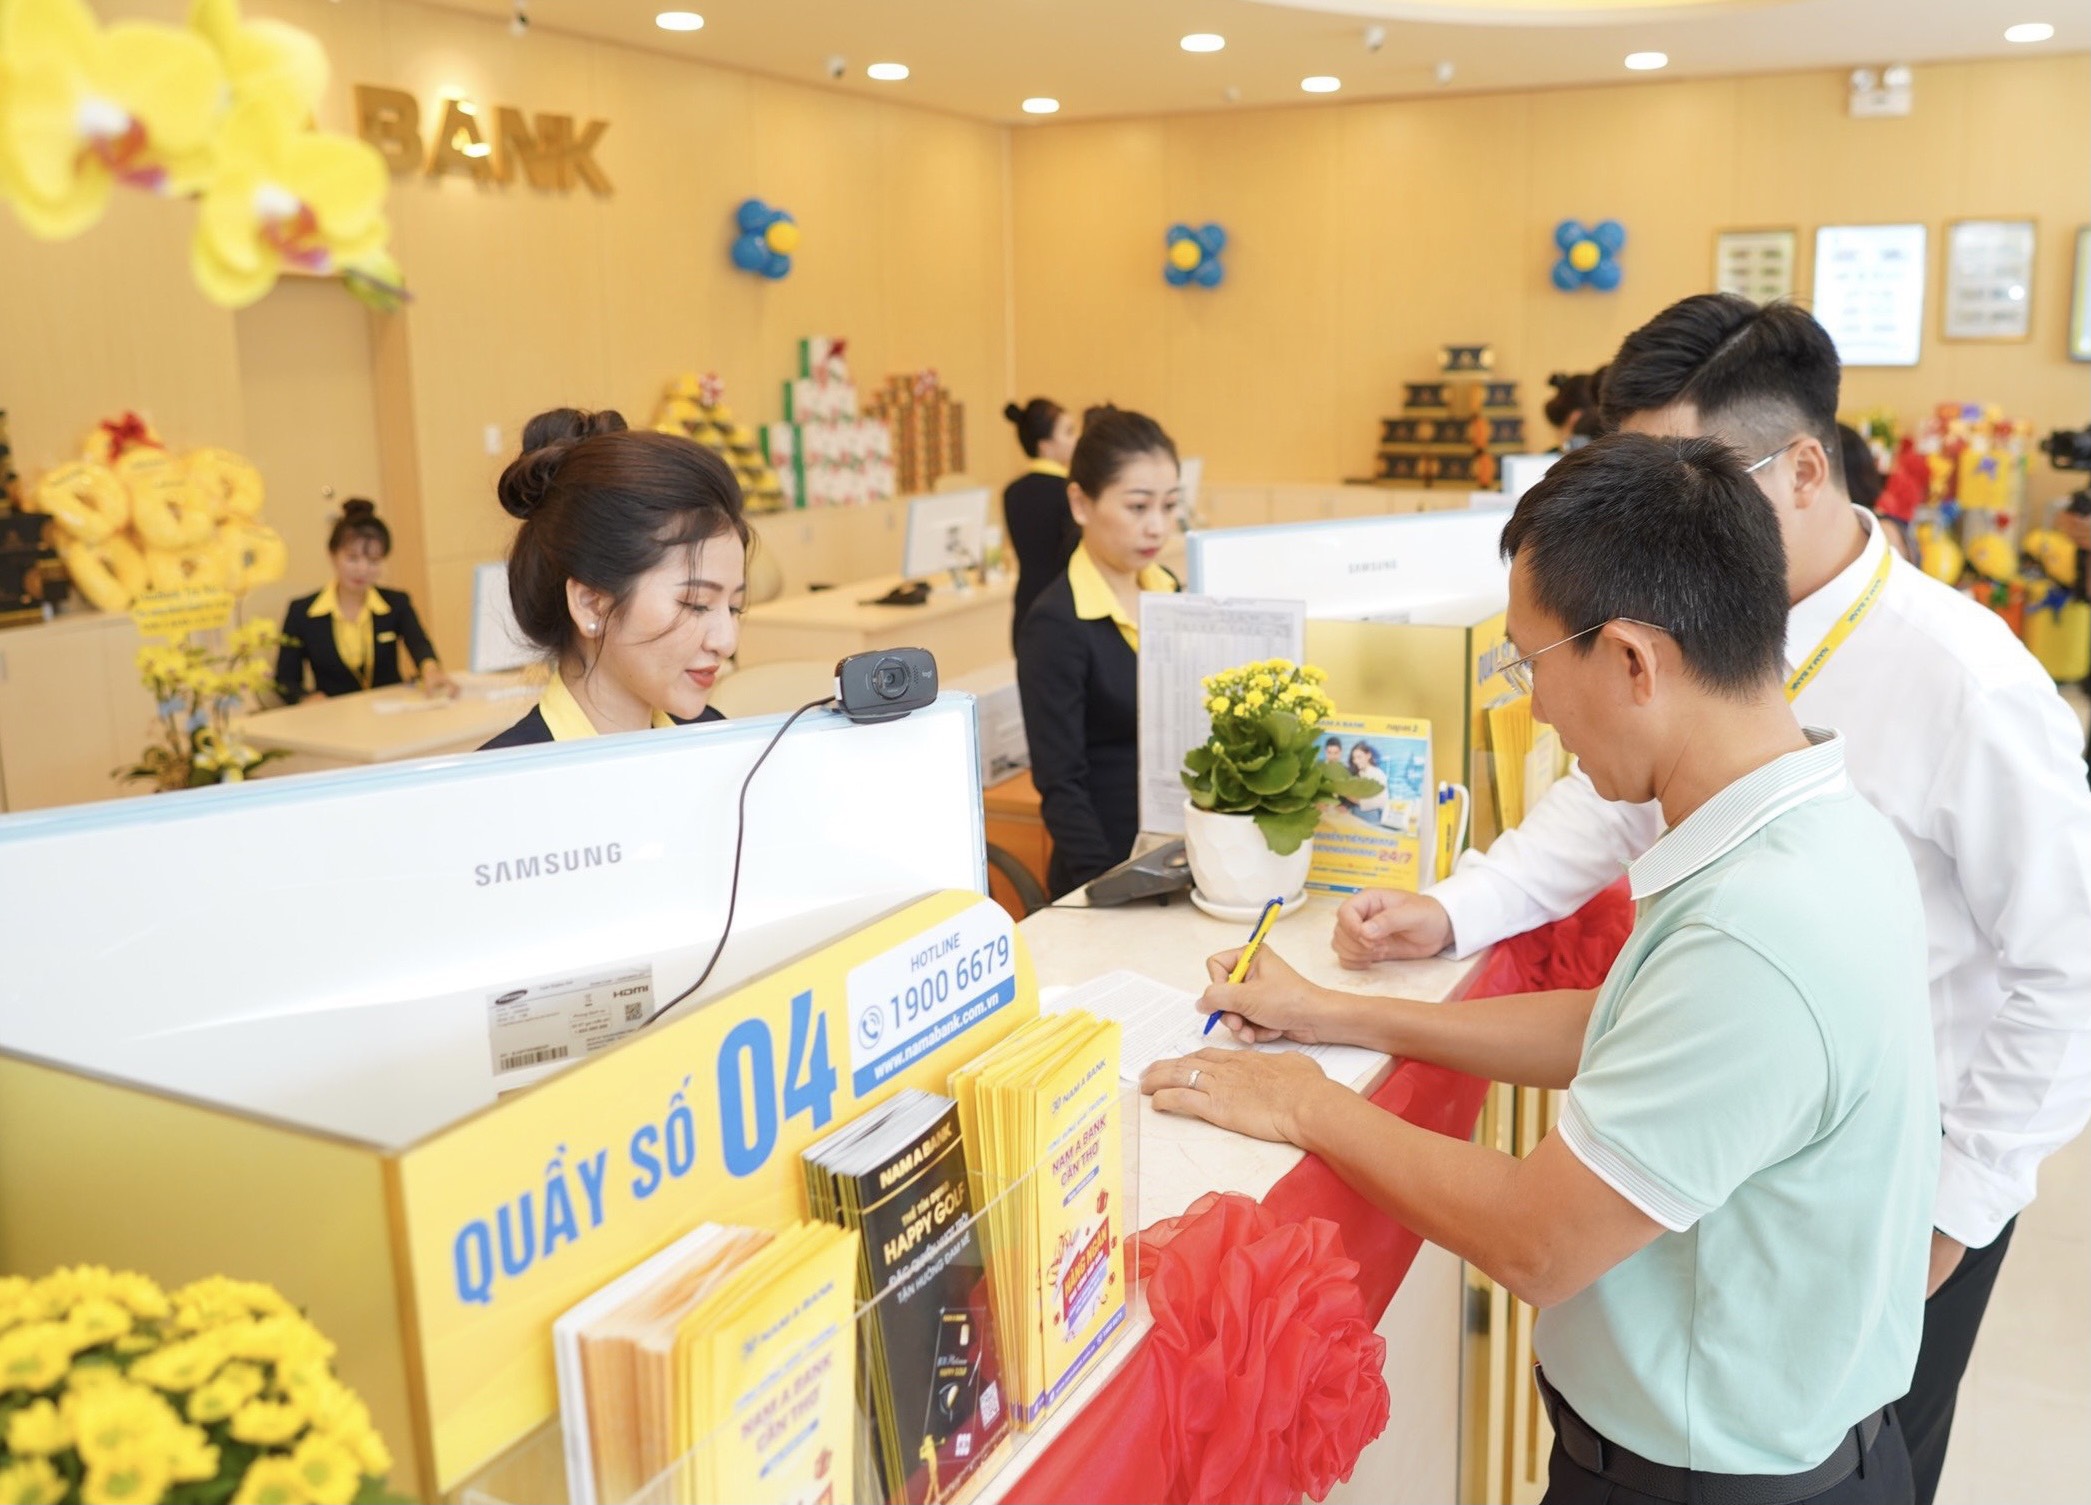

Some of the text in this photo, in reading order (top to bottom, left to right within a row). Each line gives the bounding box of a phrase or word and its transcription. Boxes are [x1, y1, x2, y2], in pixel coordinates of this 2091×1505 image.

[353, 85, 614, 197] BANK
[474, 842, 622, 887] SAMSUNG
[891, 934, 1010, 1029] 1900 6679
[910, 932, 961, 972] HOTLINE
[613, 985, 649, 998] HDMI
[873, 992, 999, 1080] www.namabank.com.vn
[453, 988, 837, 1305] QUẦY SỐ 04
[879, 1121, 953, 1190] NAM A BANK
[1052, 1147, 1074, 1175] NAM
[1083, 1112, 1107, 1144] BANK
[883, 1180, 966, 1266] HAPPY GOLF
